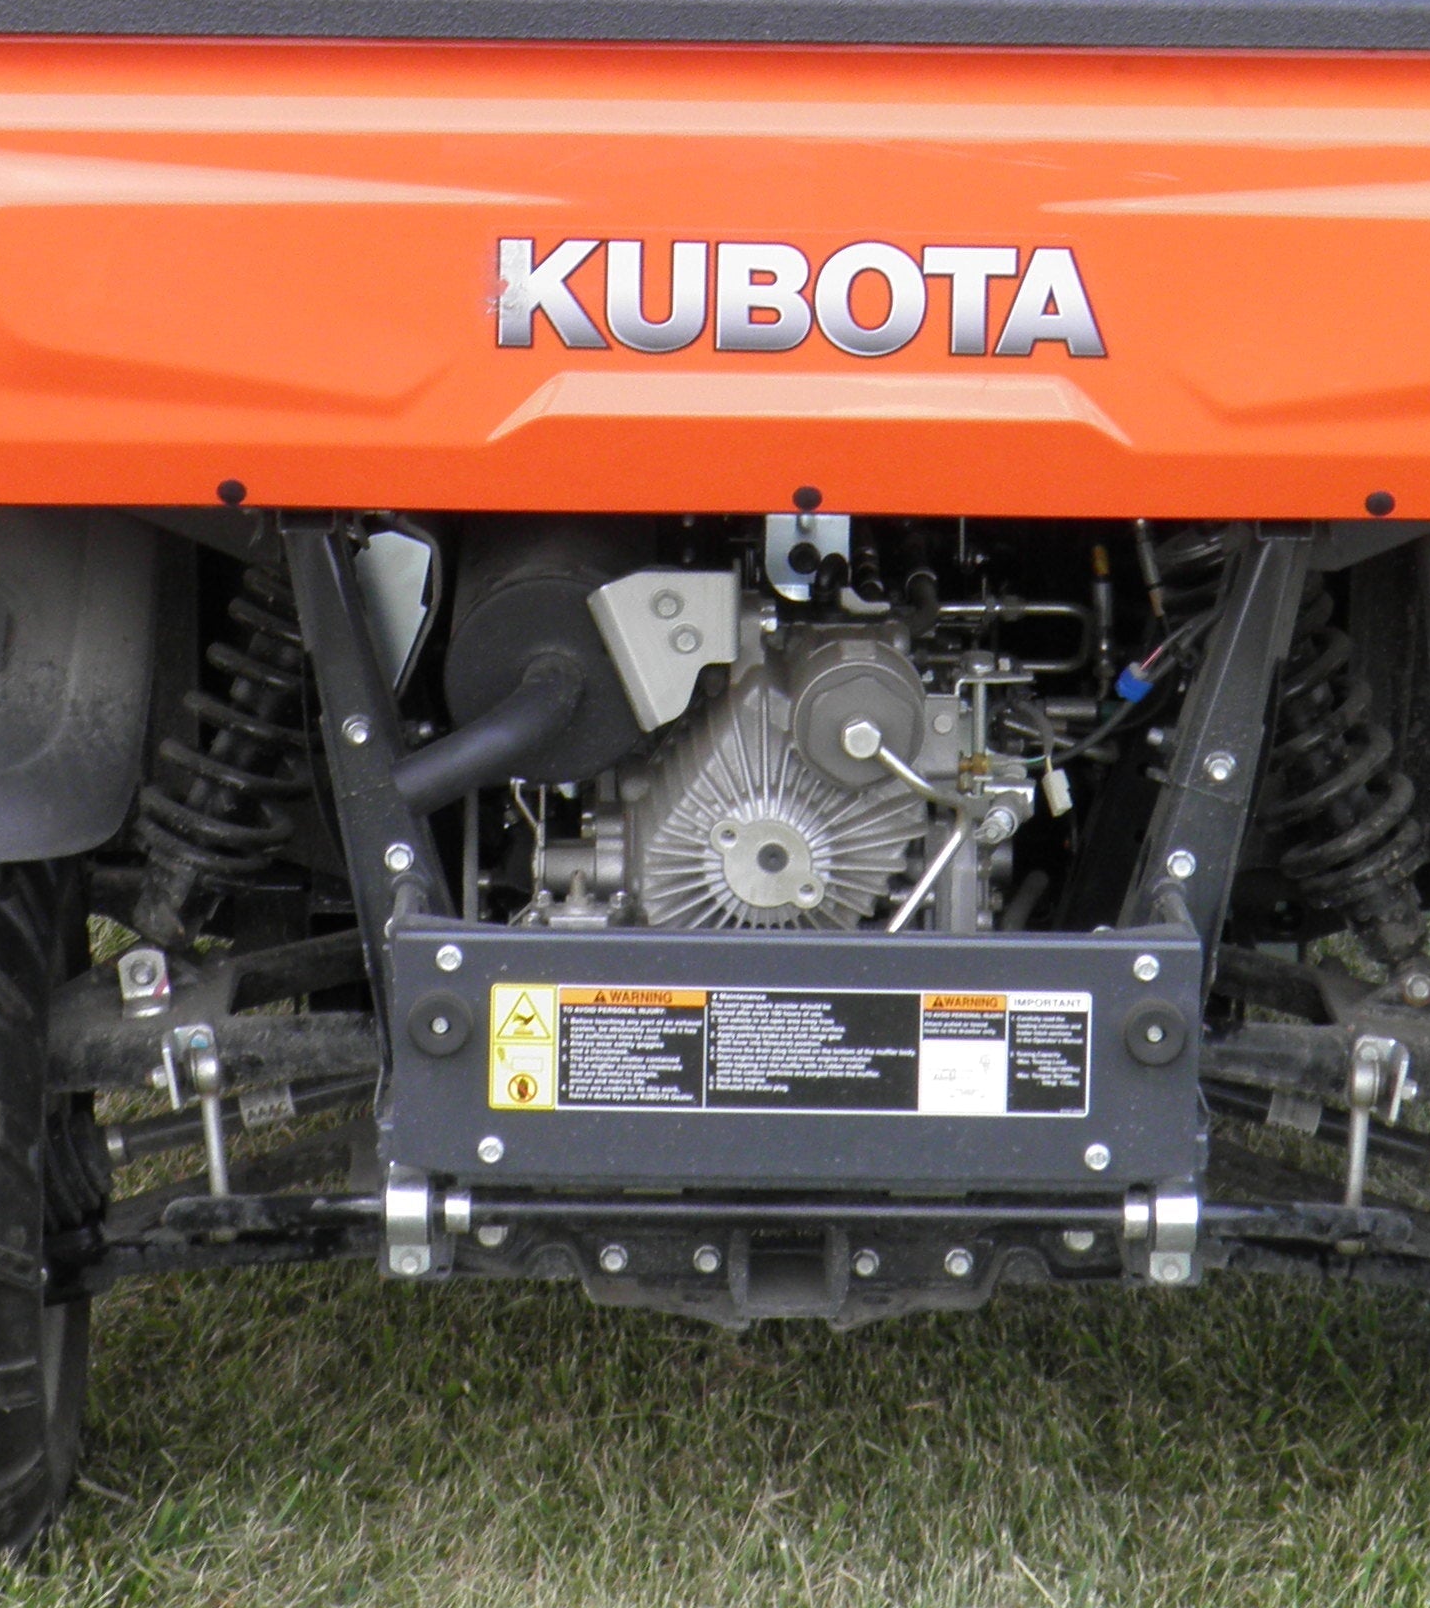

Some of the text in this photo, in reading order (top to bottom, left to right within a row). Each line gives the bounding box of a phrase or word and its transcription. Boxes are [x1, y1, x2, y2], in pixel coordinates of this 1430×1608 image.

[495, 237, 1109, 358] KUBOTA
[609, 991, 673, 1004] WARNING
[719, 992, 767, 1001] Maintenance
[942, 996, 998, 1008] WARNING
[1013, 998, 1082, 1008] IMPORTANT
[598, 1006, 637, 1015] PERSONAL
